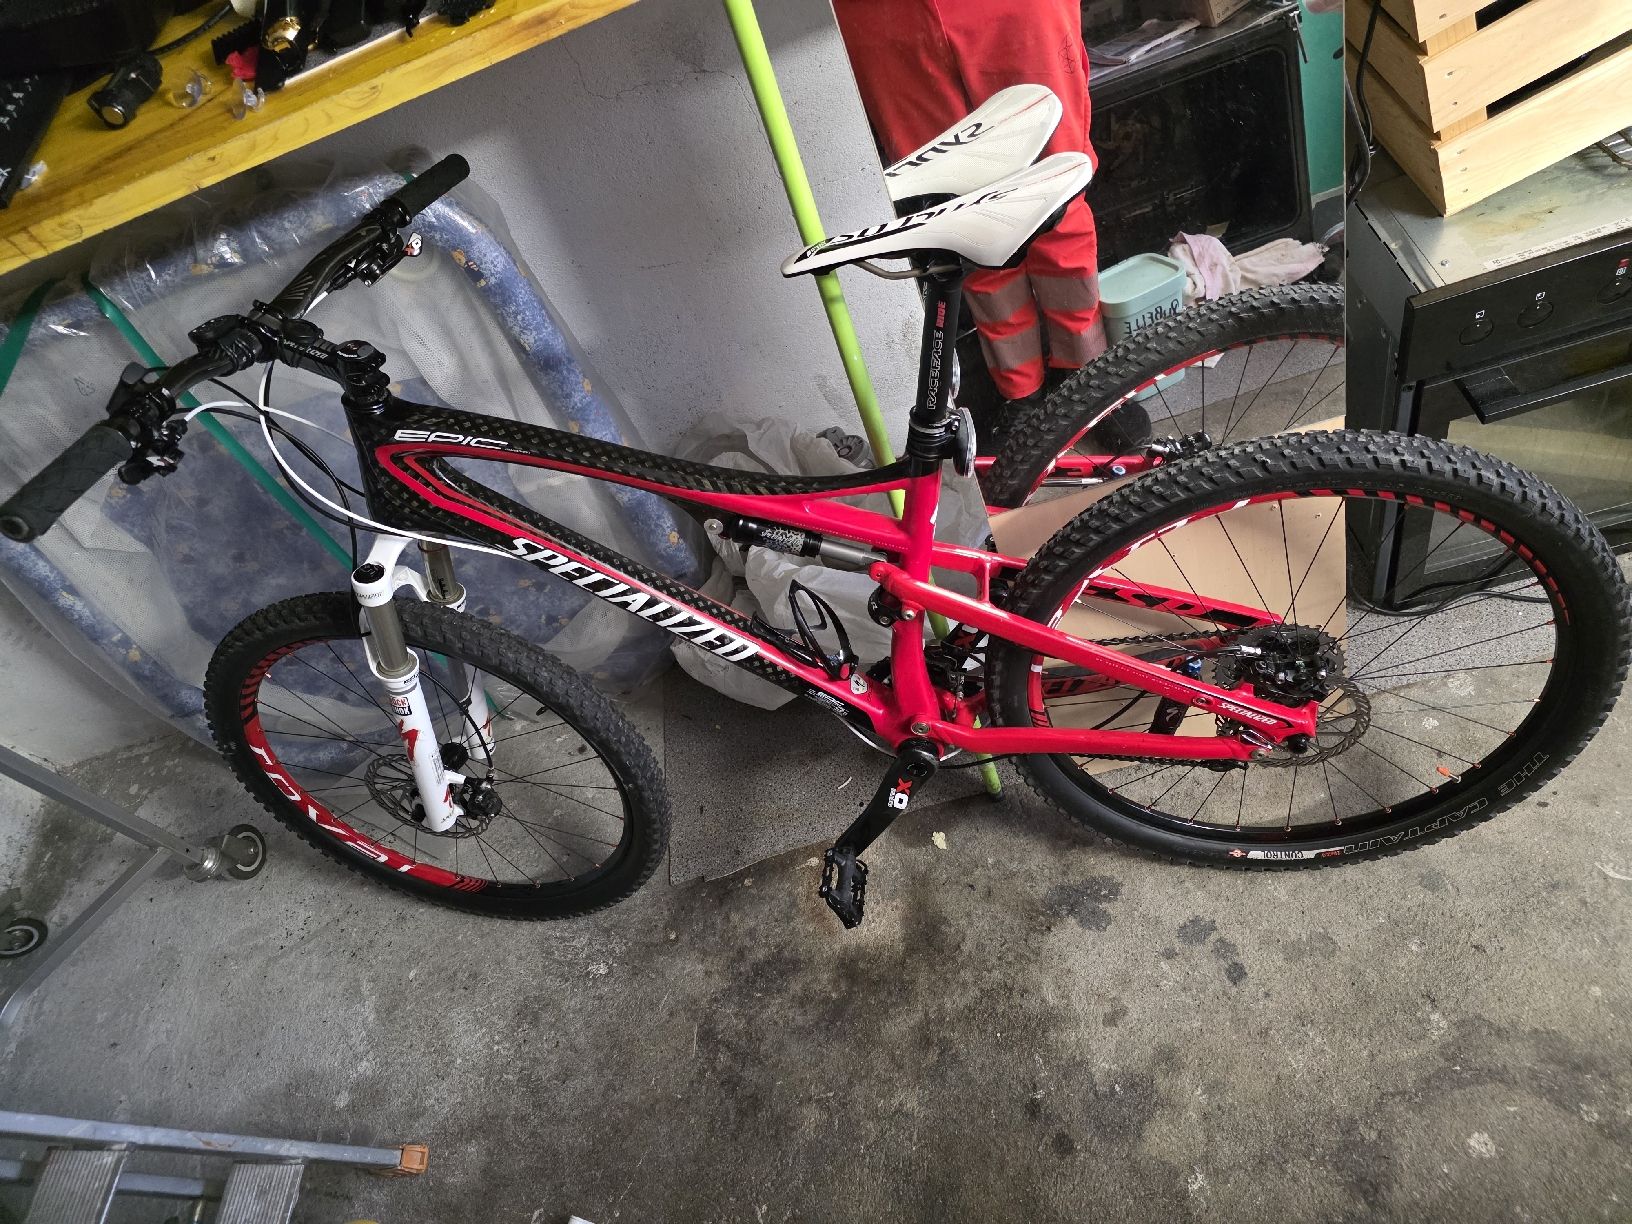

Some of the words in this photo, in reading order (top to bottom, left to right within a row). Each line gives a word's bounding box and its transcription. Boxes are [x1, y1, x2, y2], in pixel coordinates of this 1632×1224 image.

[394, 429, 508, 449] EPIC
[512, 537, 761, 662] SPECIALIZED
[1217, 702, 1277, 725] SPECIALIZED
[1497, 751, 1550, 797] THE
